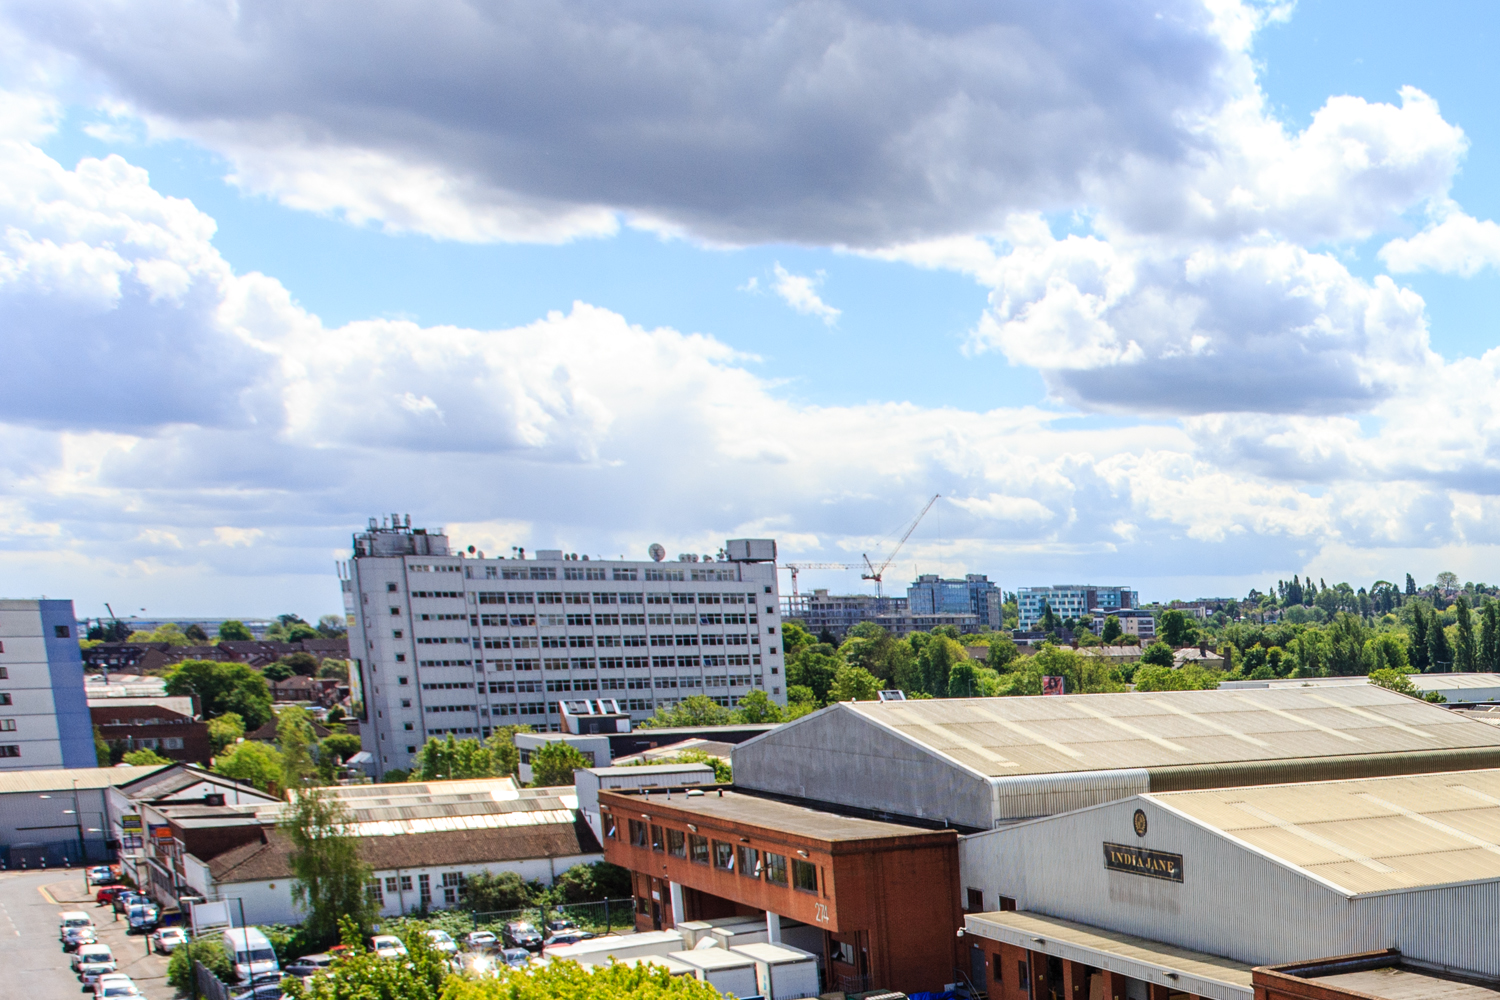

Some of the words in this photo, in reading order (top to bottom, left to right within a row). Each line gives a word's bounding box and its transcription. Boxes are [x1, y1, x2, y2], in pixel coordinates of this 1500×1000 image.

[1111, 851, 1144, 868] INDIA
[1145, 858, 1175, 873] JANE
[815, 902, 829, 924] 274
